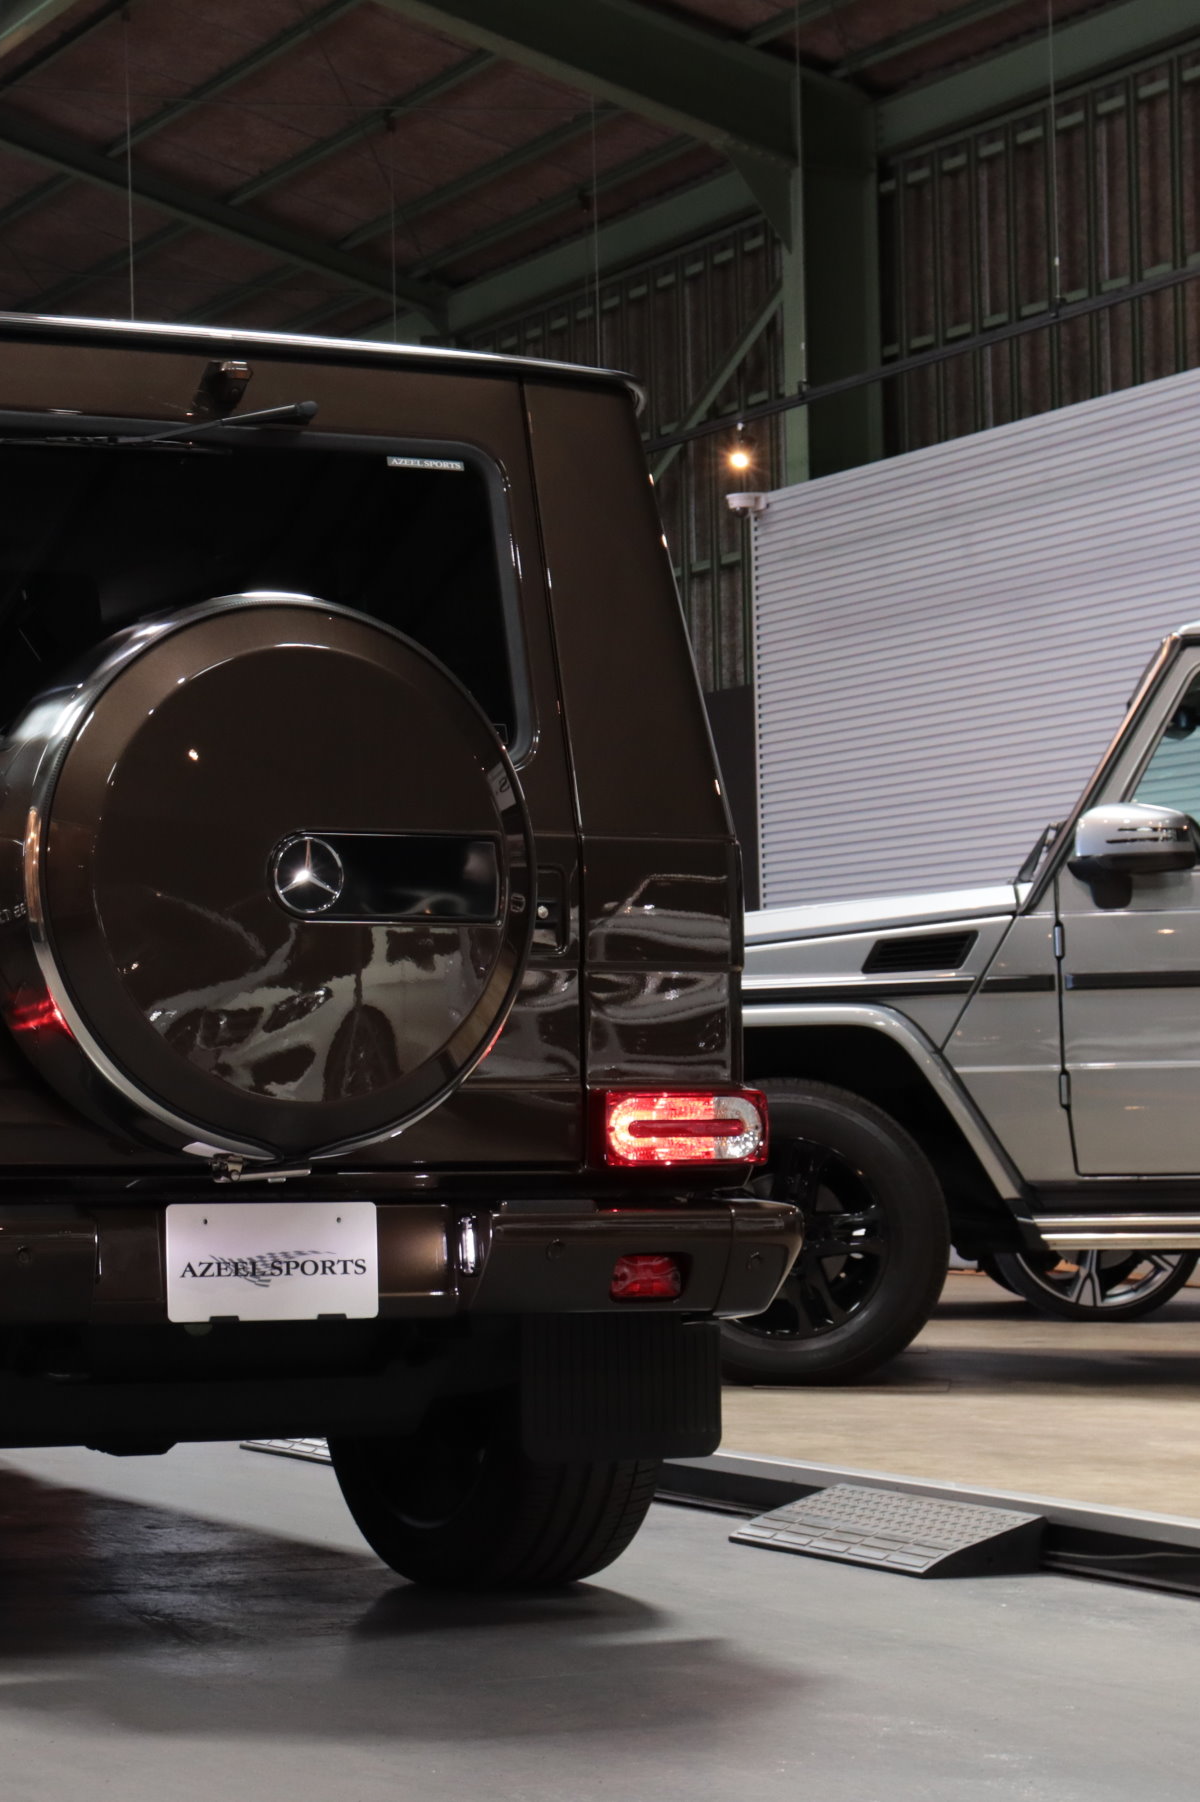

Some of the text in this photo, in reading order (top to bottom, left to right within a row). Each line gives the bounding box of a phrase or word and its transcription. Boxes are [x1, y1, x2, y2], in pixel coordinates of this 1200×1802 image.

[391, 457, 462, 469] AZEEL SPORTS
[180, 1258, 367, 1278] AZEEL SPORTS
